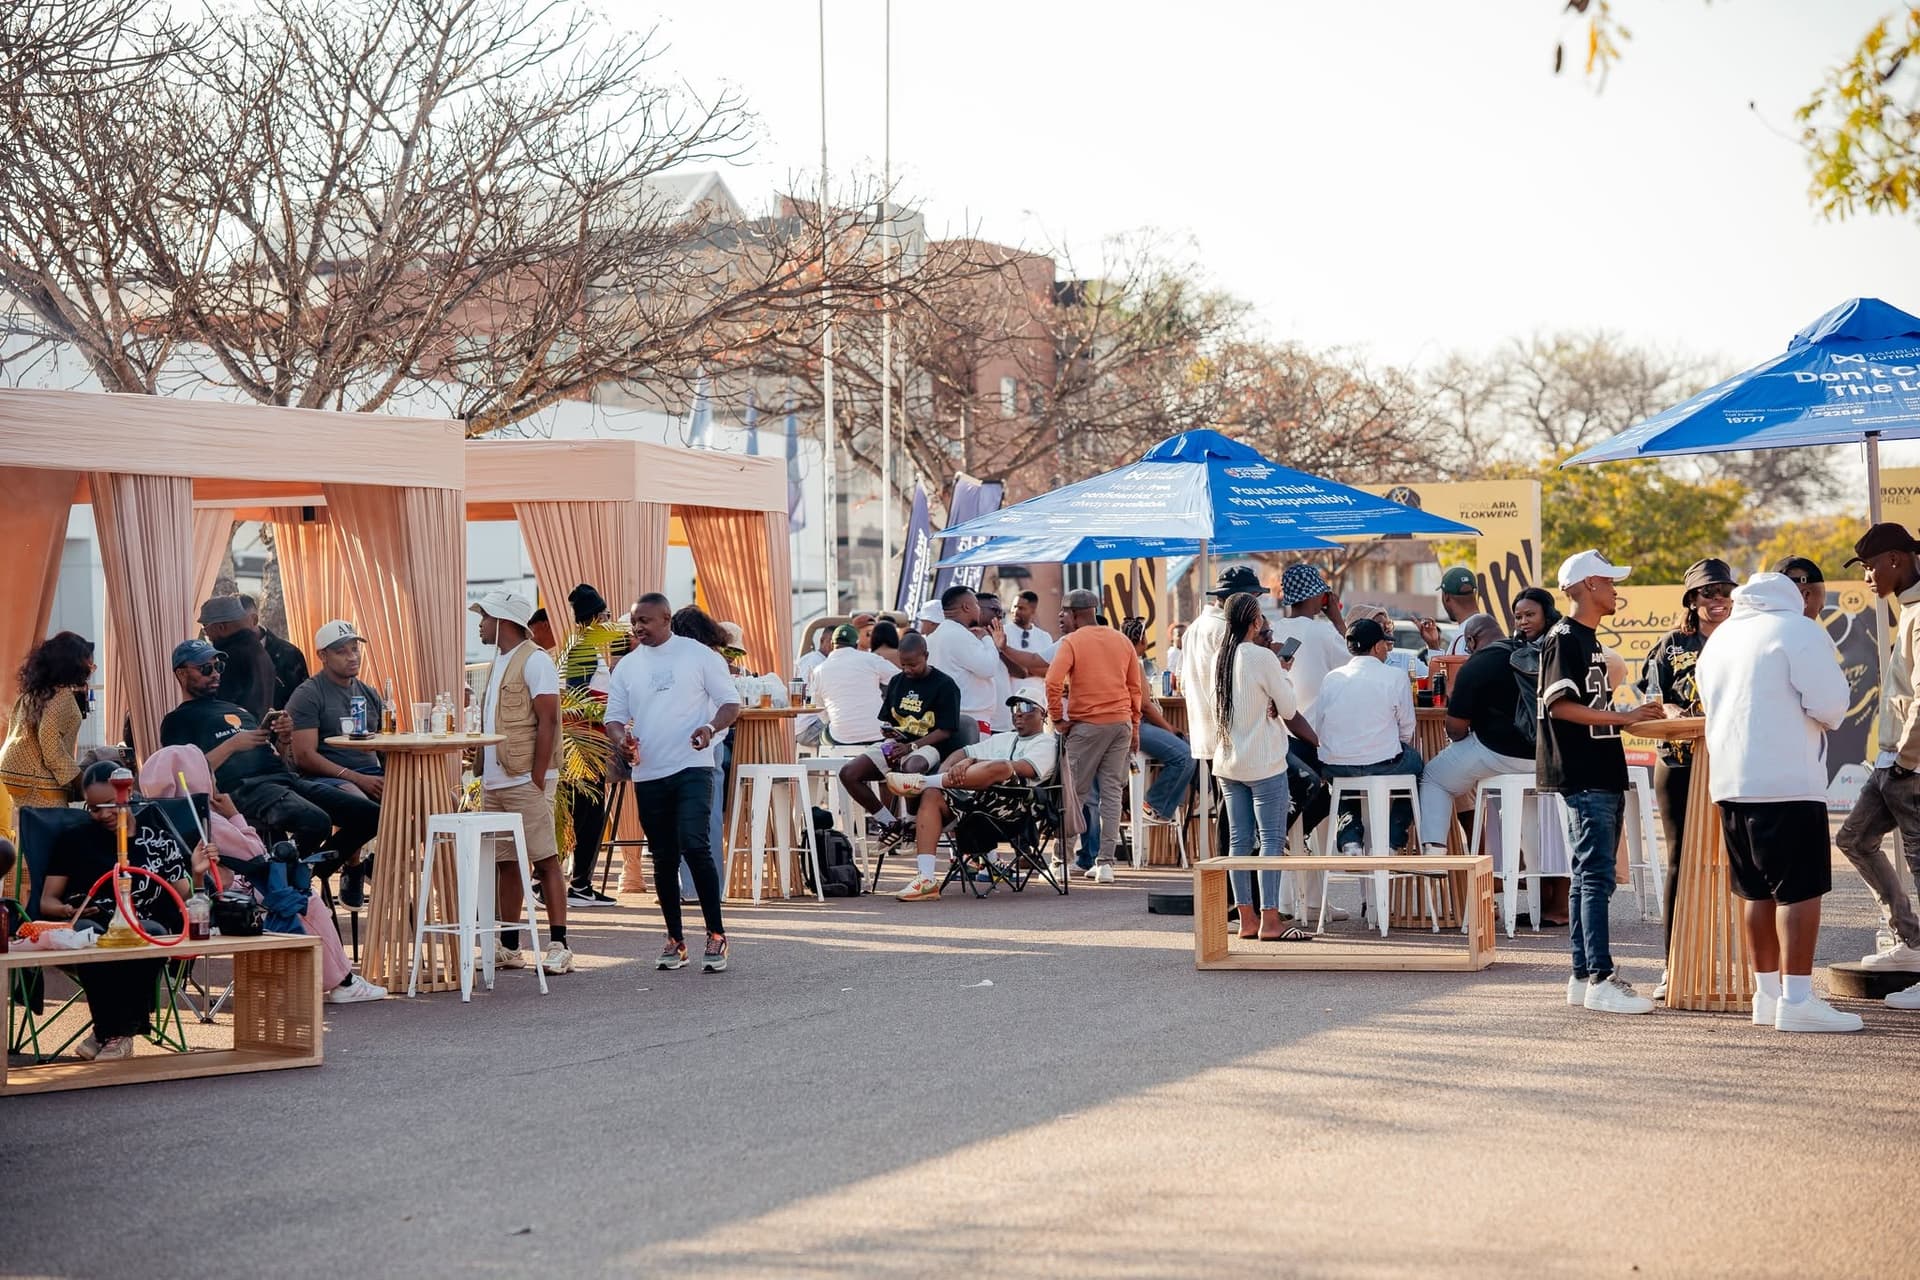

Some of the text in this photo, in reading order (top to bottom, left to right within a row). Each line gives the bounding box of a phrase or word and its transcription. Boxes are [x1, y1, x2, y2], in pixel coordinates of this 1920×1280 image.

[1793, 363, 1920, 383] Don't C
[1827, 383, 1893, 397] The
[1228, 495, 1357, 509] Play Responsibly.
[1460, 510, 1519, 519] TLOKWENG
